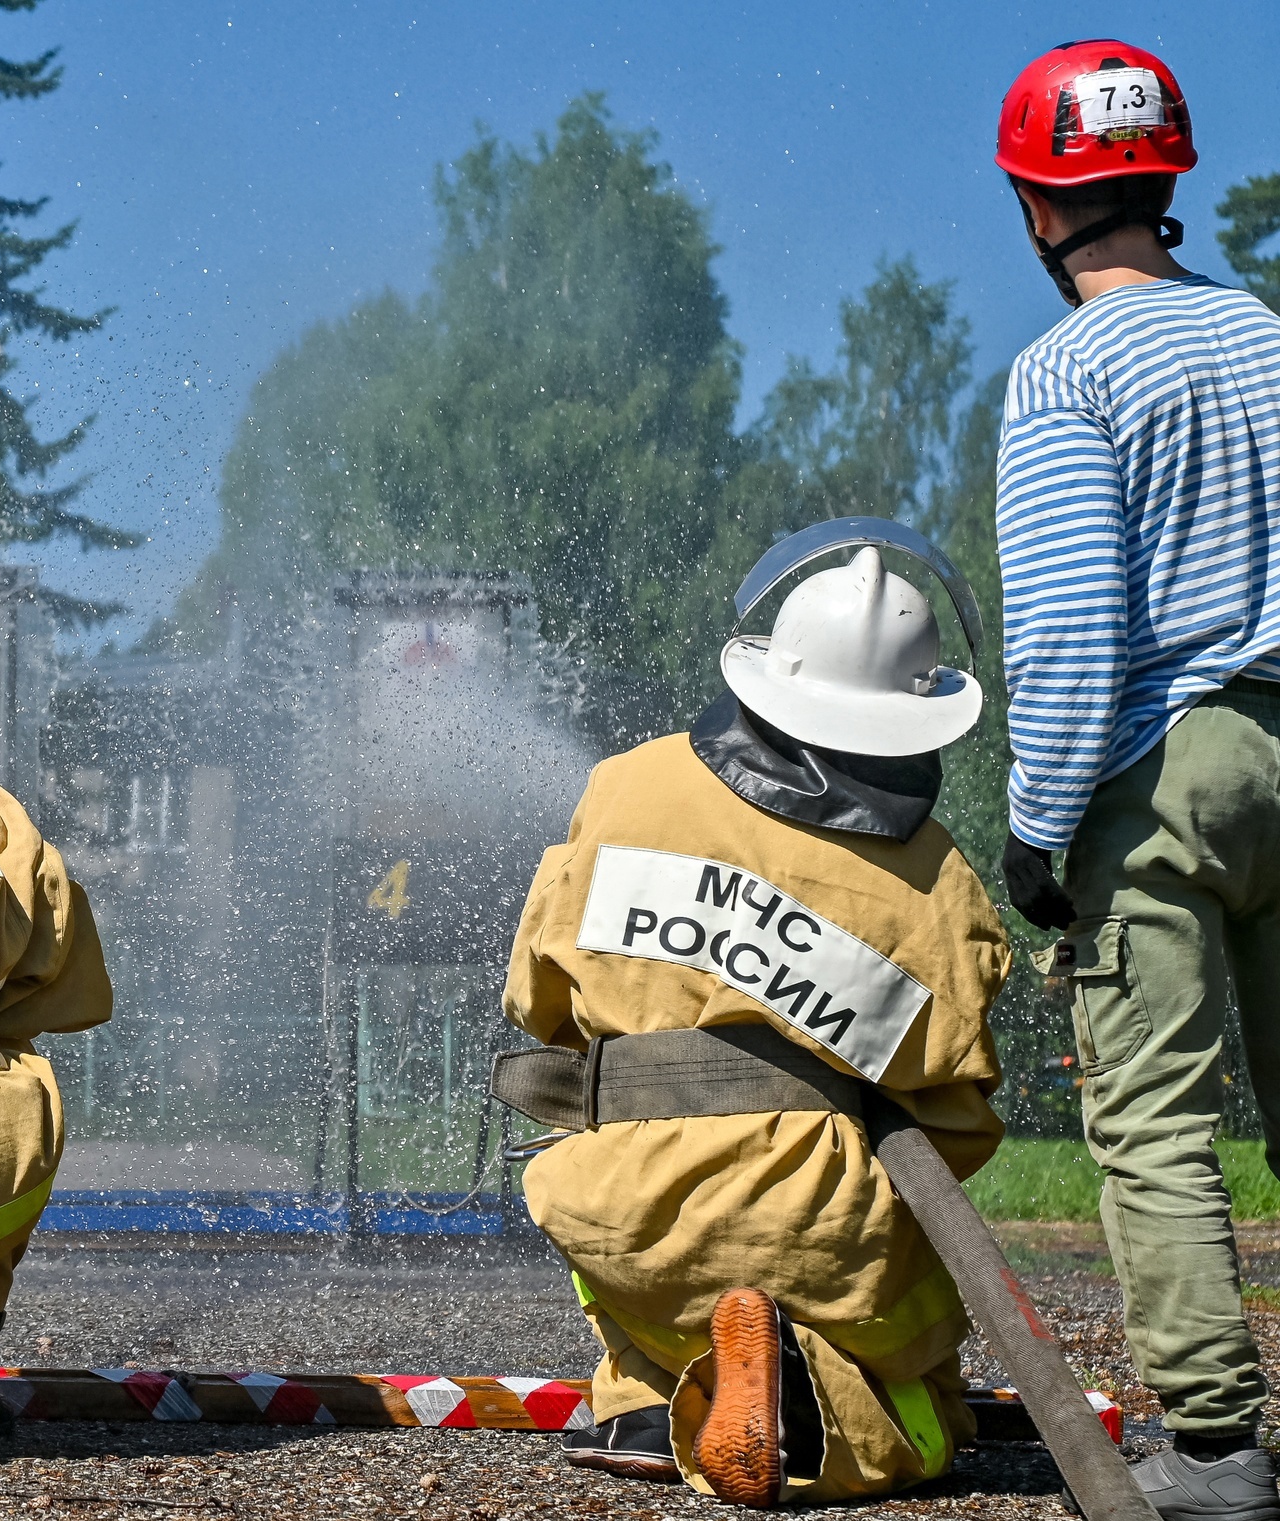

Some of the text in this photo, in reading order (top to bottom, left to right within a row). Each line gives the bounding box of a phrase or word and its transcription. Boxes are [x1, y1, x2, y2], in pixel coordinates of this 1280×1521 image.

[1099, 84, 1147, 111] 7.3
[367, 858, 411, 919] 4
[695, 864, 822, 952] МЧС
[622, 907, 857, 1046] РОССИИ
